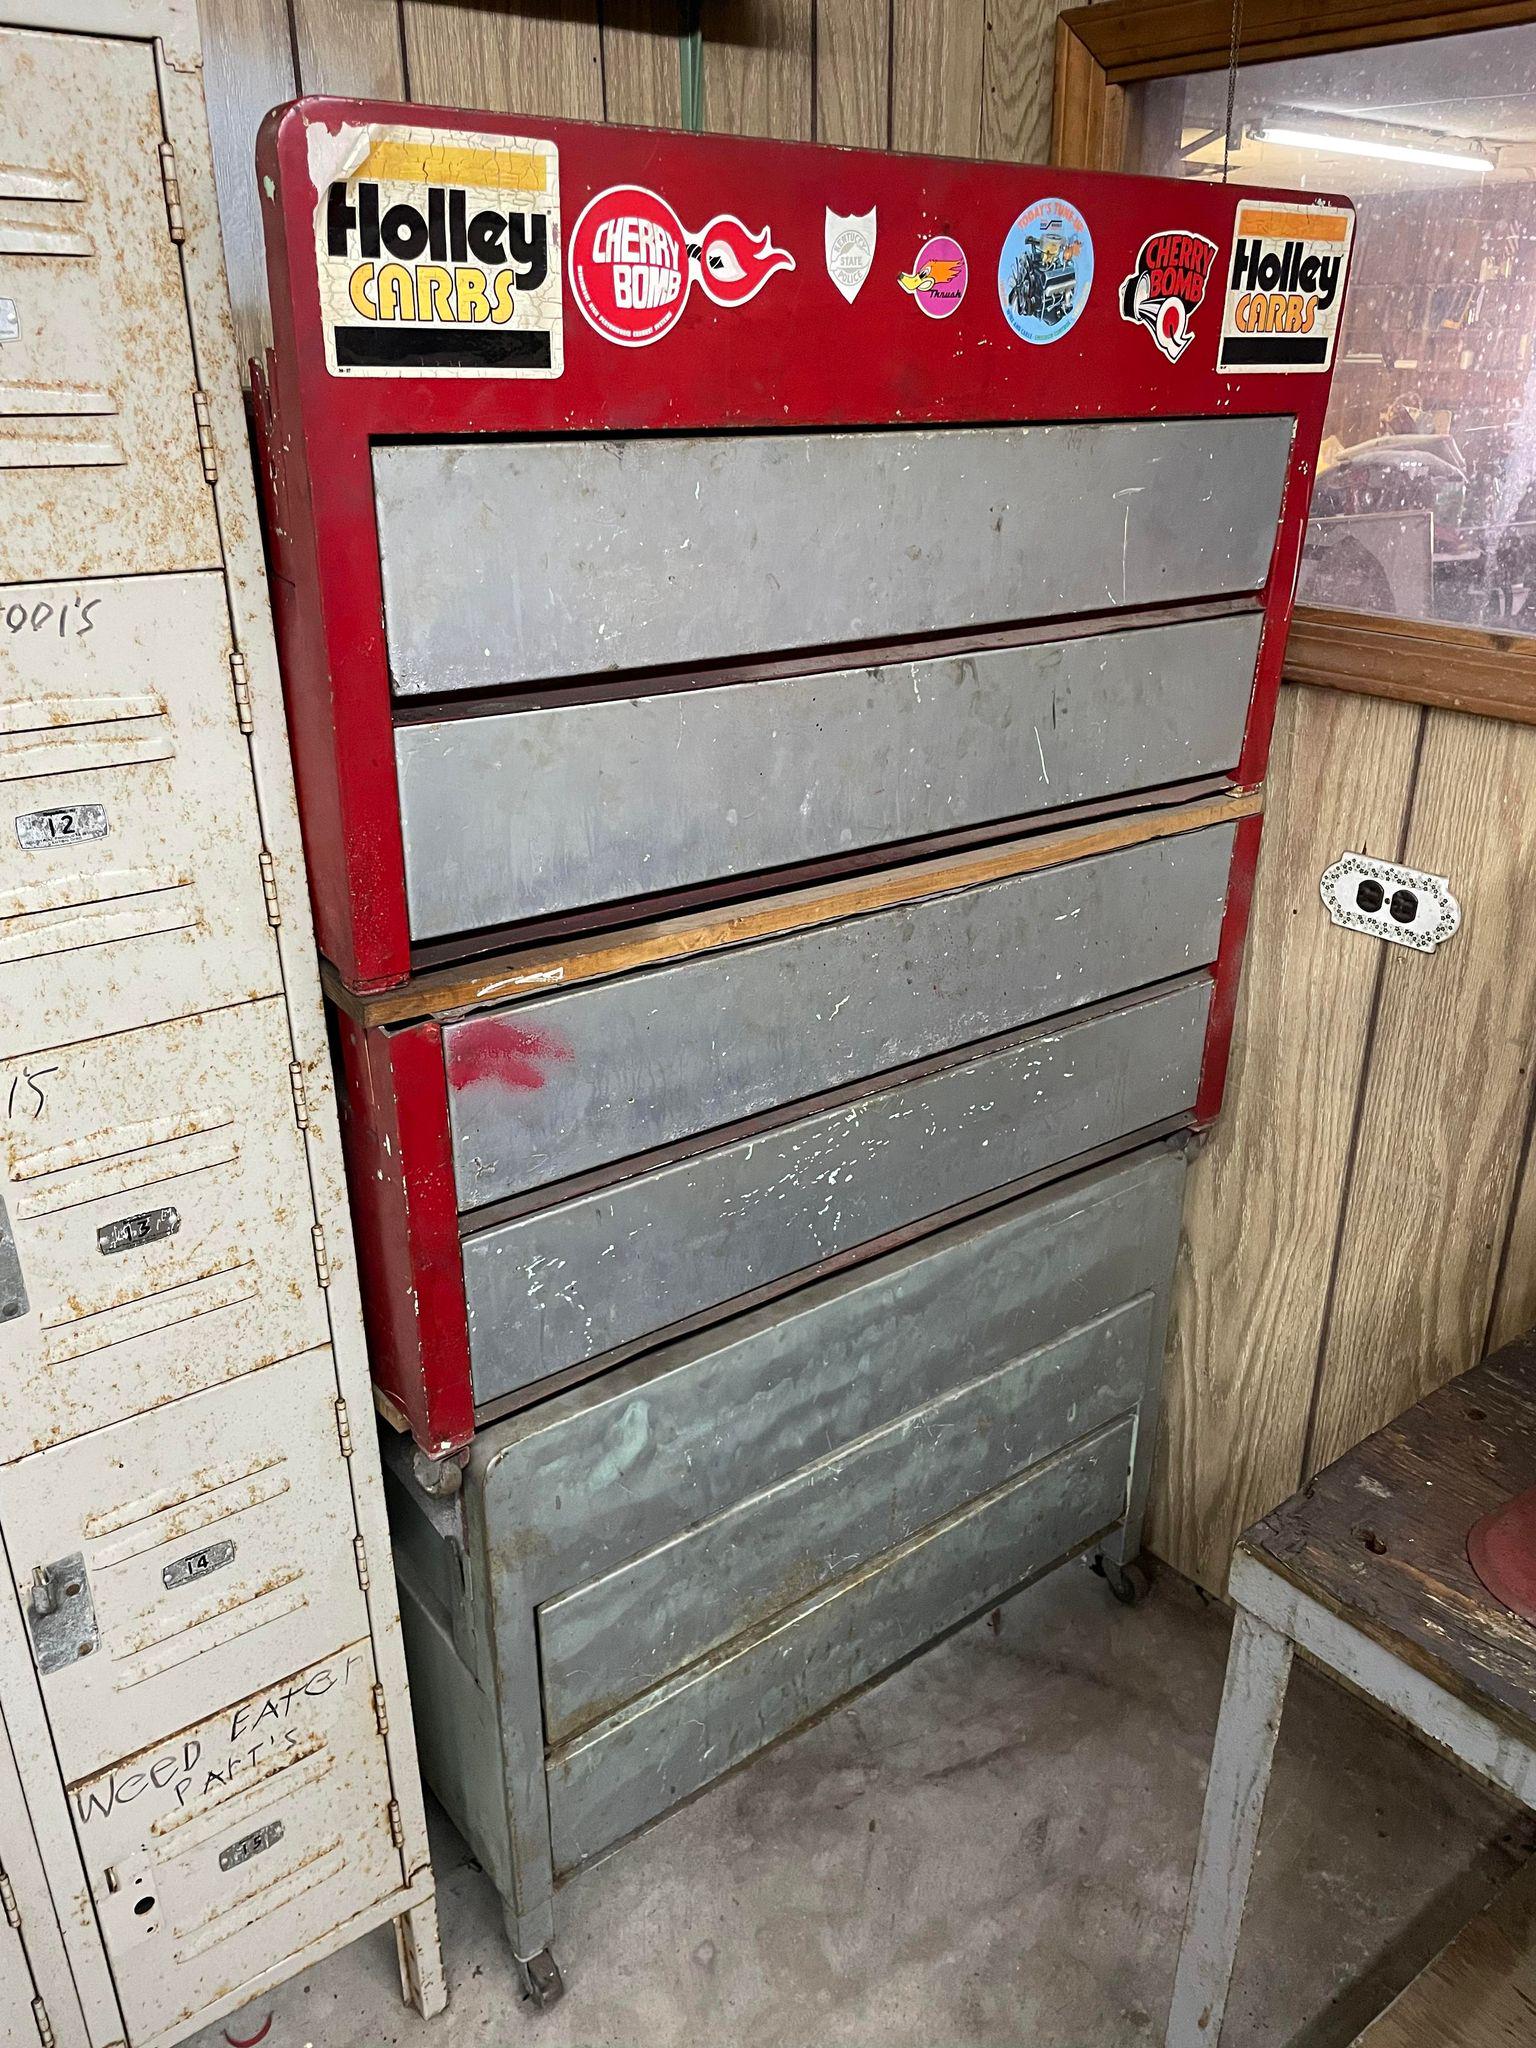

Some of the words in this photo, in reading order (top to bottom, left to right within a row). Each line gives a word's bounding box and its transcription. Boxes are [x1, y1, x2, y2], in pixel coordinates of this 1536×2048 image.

[327, 182, 548, 291] Holley
[592, 216, 680, 271] CHERRY
[833, 232, 868, 252] KENTUCKY
[840, 256, 862, 266] STATE
[1145, 235, 1215, 275] CHERRY
[612, 264, 682, 310] BOMB
[838, 270, 863, 283] POLICE
[1150, 268, 1205, 303] BOMB
[1231, 239, 1341, 310] Holley
[349, 262, 515, 324] CARBS
[928, 288, 963, 299] Thrush
[1235, 292, 1319, 333] CARBS
[47, 815, 76, 838] 12
[125, 1219, 151, 1241] 13
[187, 1554, 210, 1575] 14
[242, 1835, 262, 1855] 15
